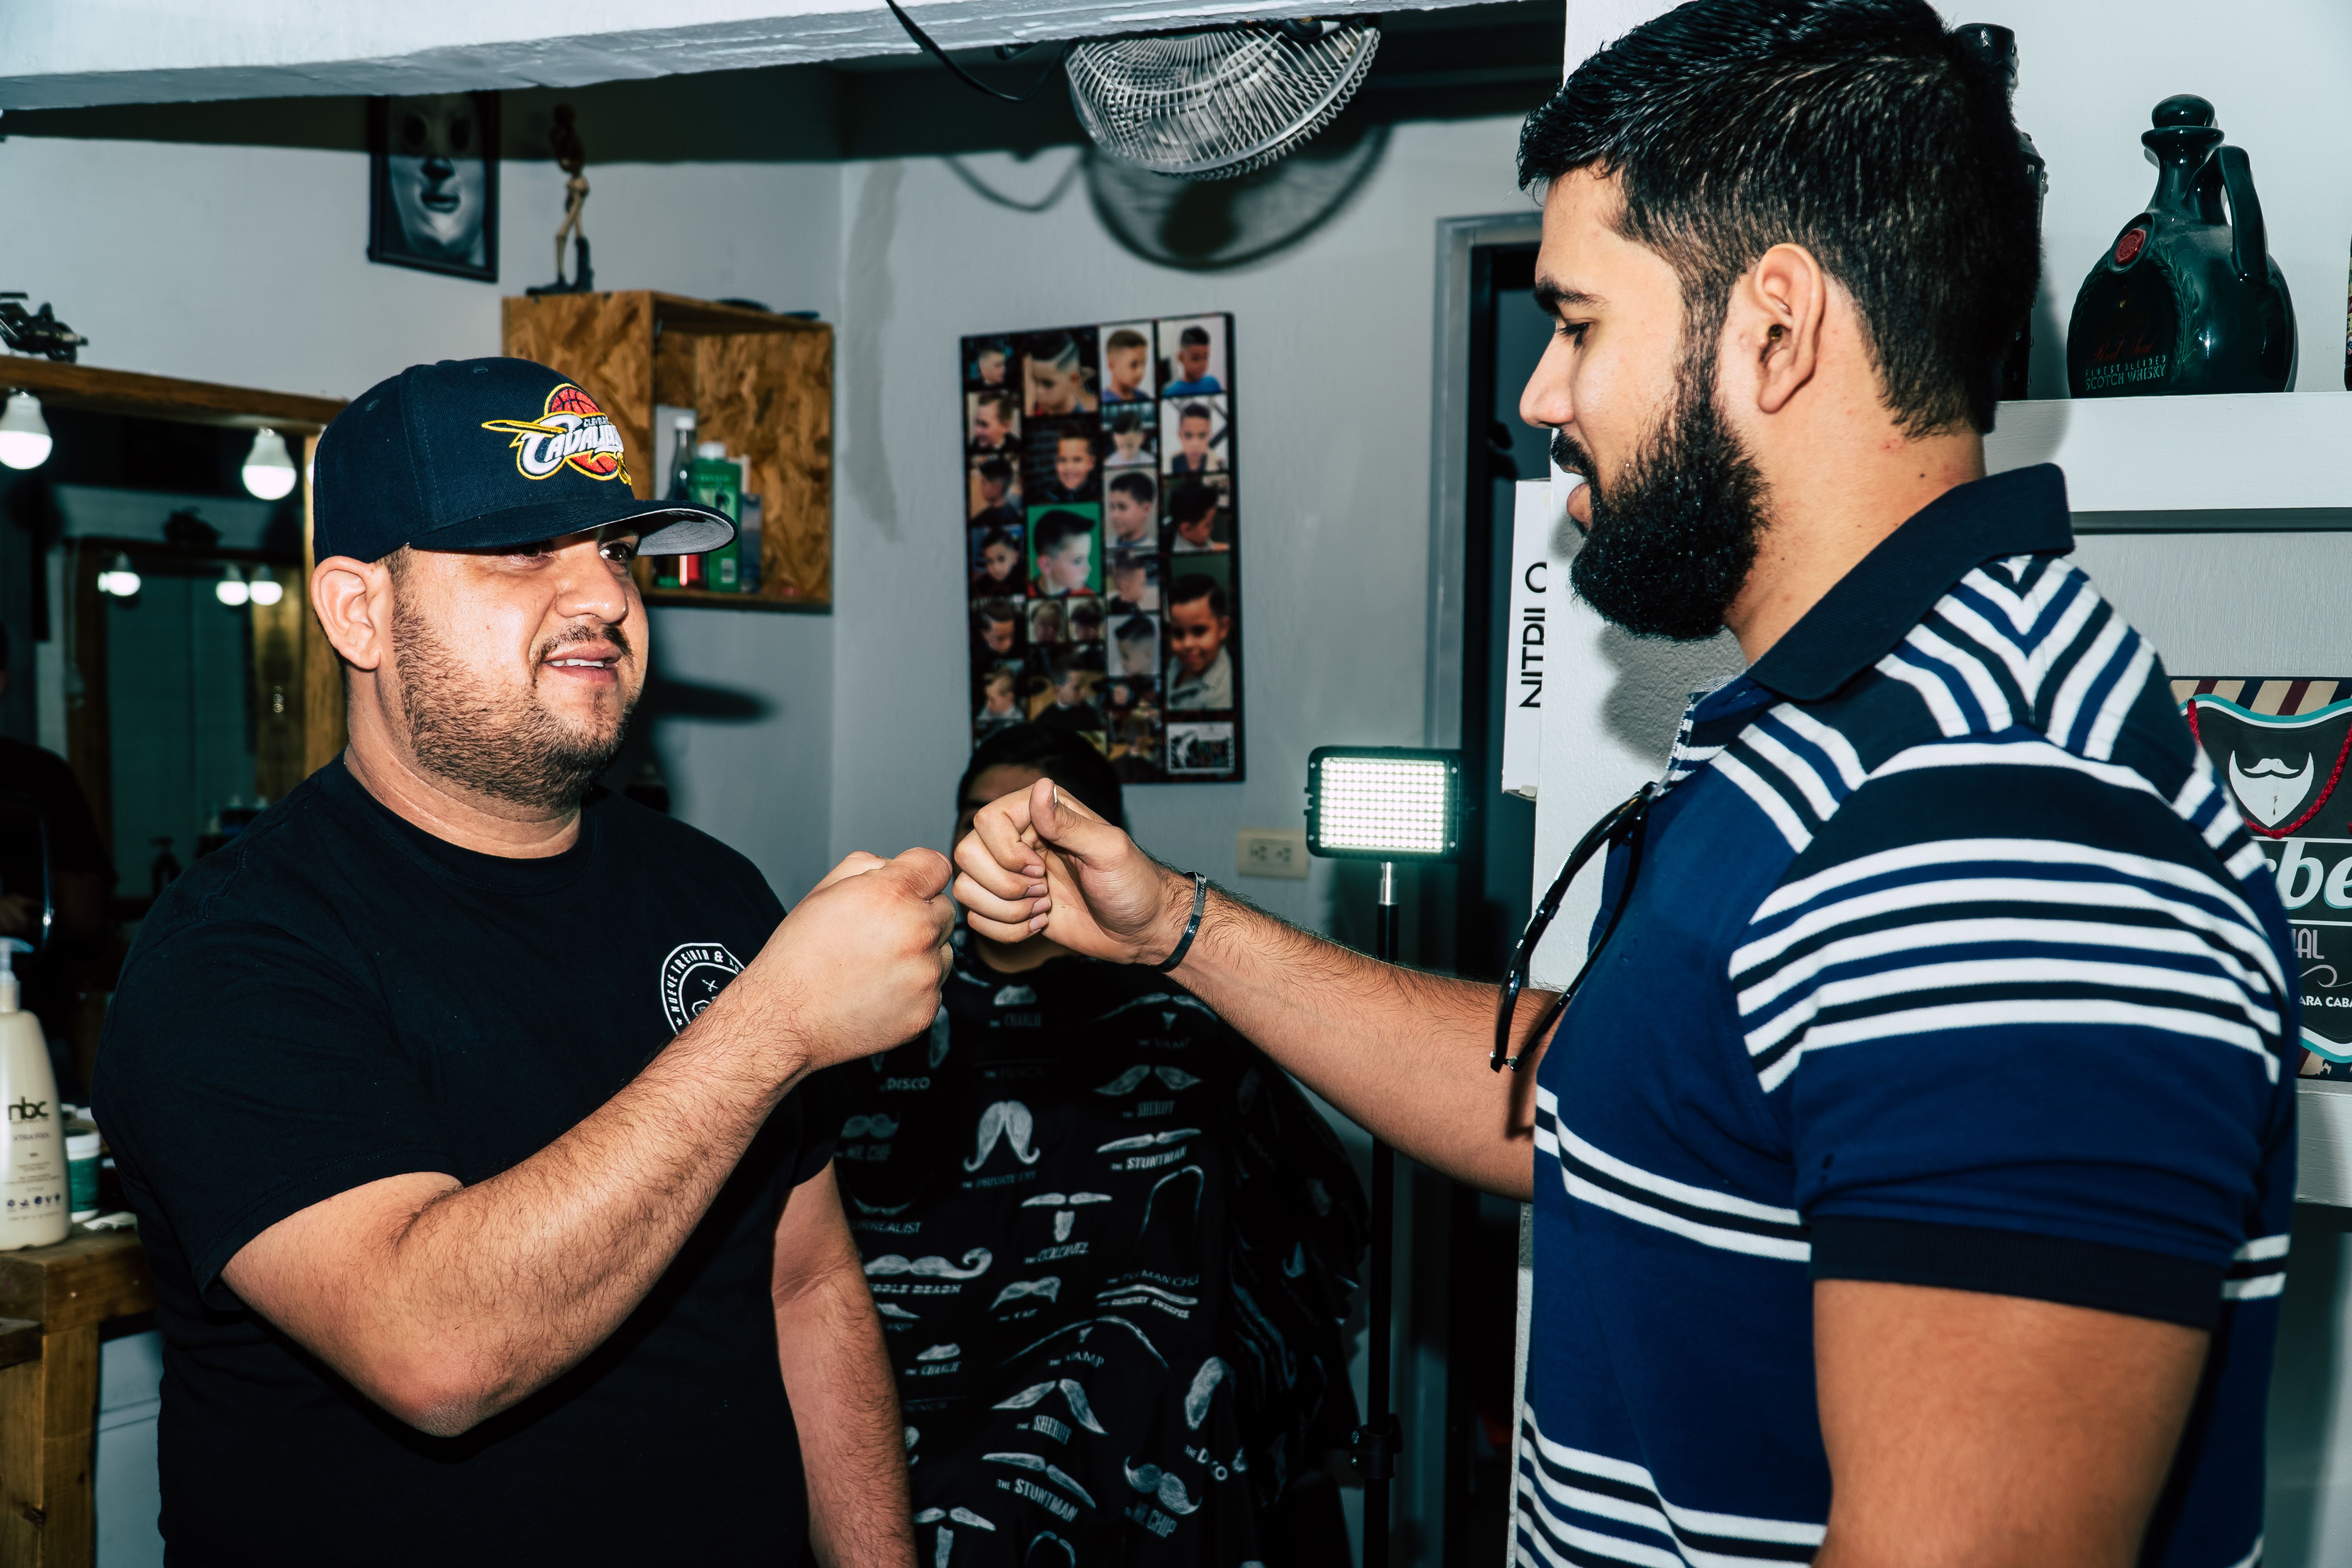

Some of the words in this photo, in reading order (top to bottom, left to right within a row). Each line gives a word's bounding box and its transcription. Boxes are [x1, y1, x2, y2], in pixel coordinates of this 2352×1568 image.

[2085, 372, 2124, 390] SCOTCH
[2127, 364, 2166, 383] WHISKY
[714, 951, 724, 963] &
[2299, 995, 2323, 1006] ARA
[886, 1076, 931, 1091] DISCO
[8, 1096, 49, 1120] nbc
[1014, 1478, 1079, 1523] STUNTMAN
